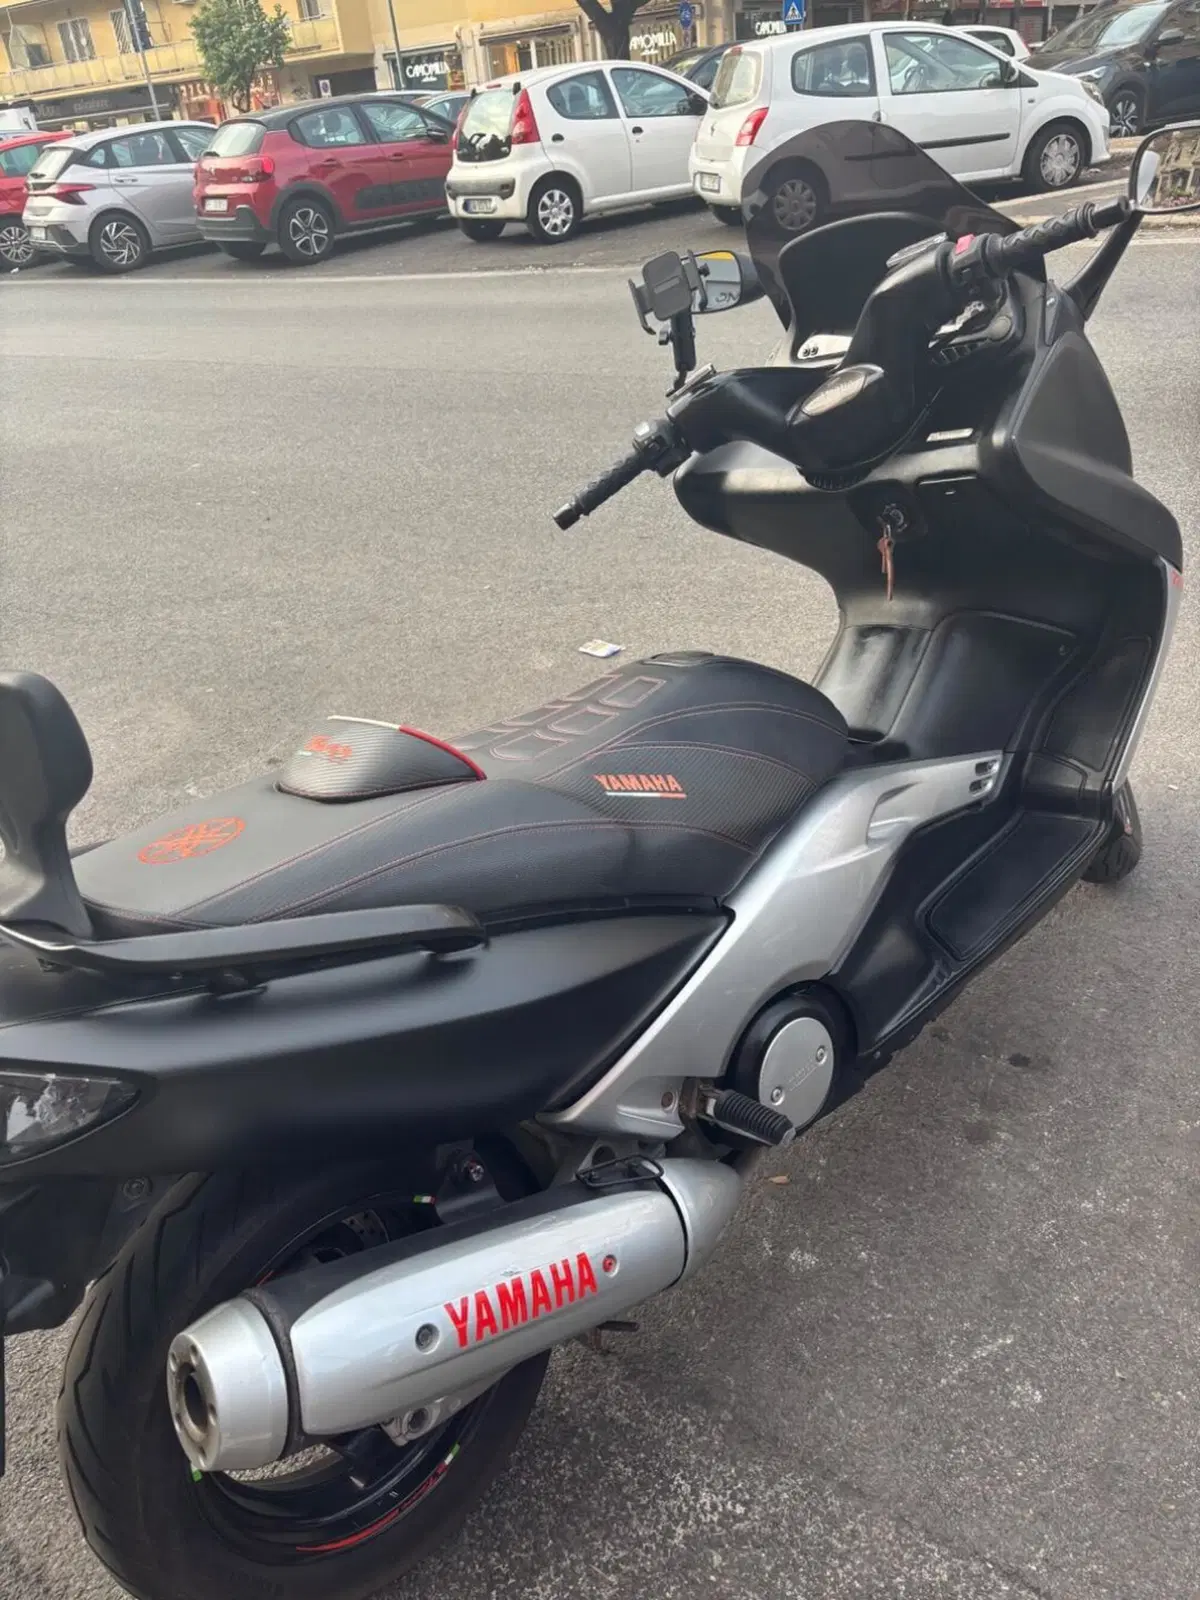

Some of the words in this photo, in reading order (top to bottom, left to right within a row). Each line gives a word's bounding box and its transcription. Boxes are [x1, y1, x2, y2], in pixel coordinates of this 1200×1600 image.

[629, 30, 677, 51] AMOMILLA
[593, 774, 683, 791] YAMAHA
[444, 1252, 598, 1348] YAMAHA
